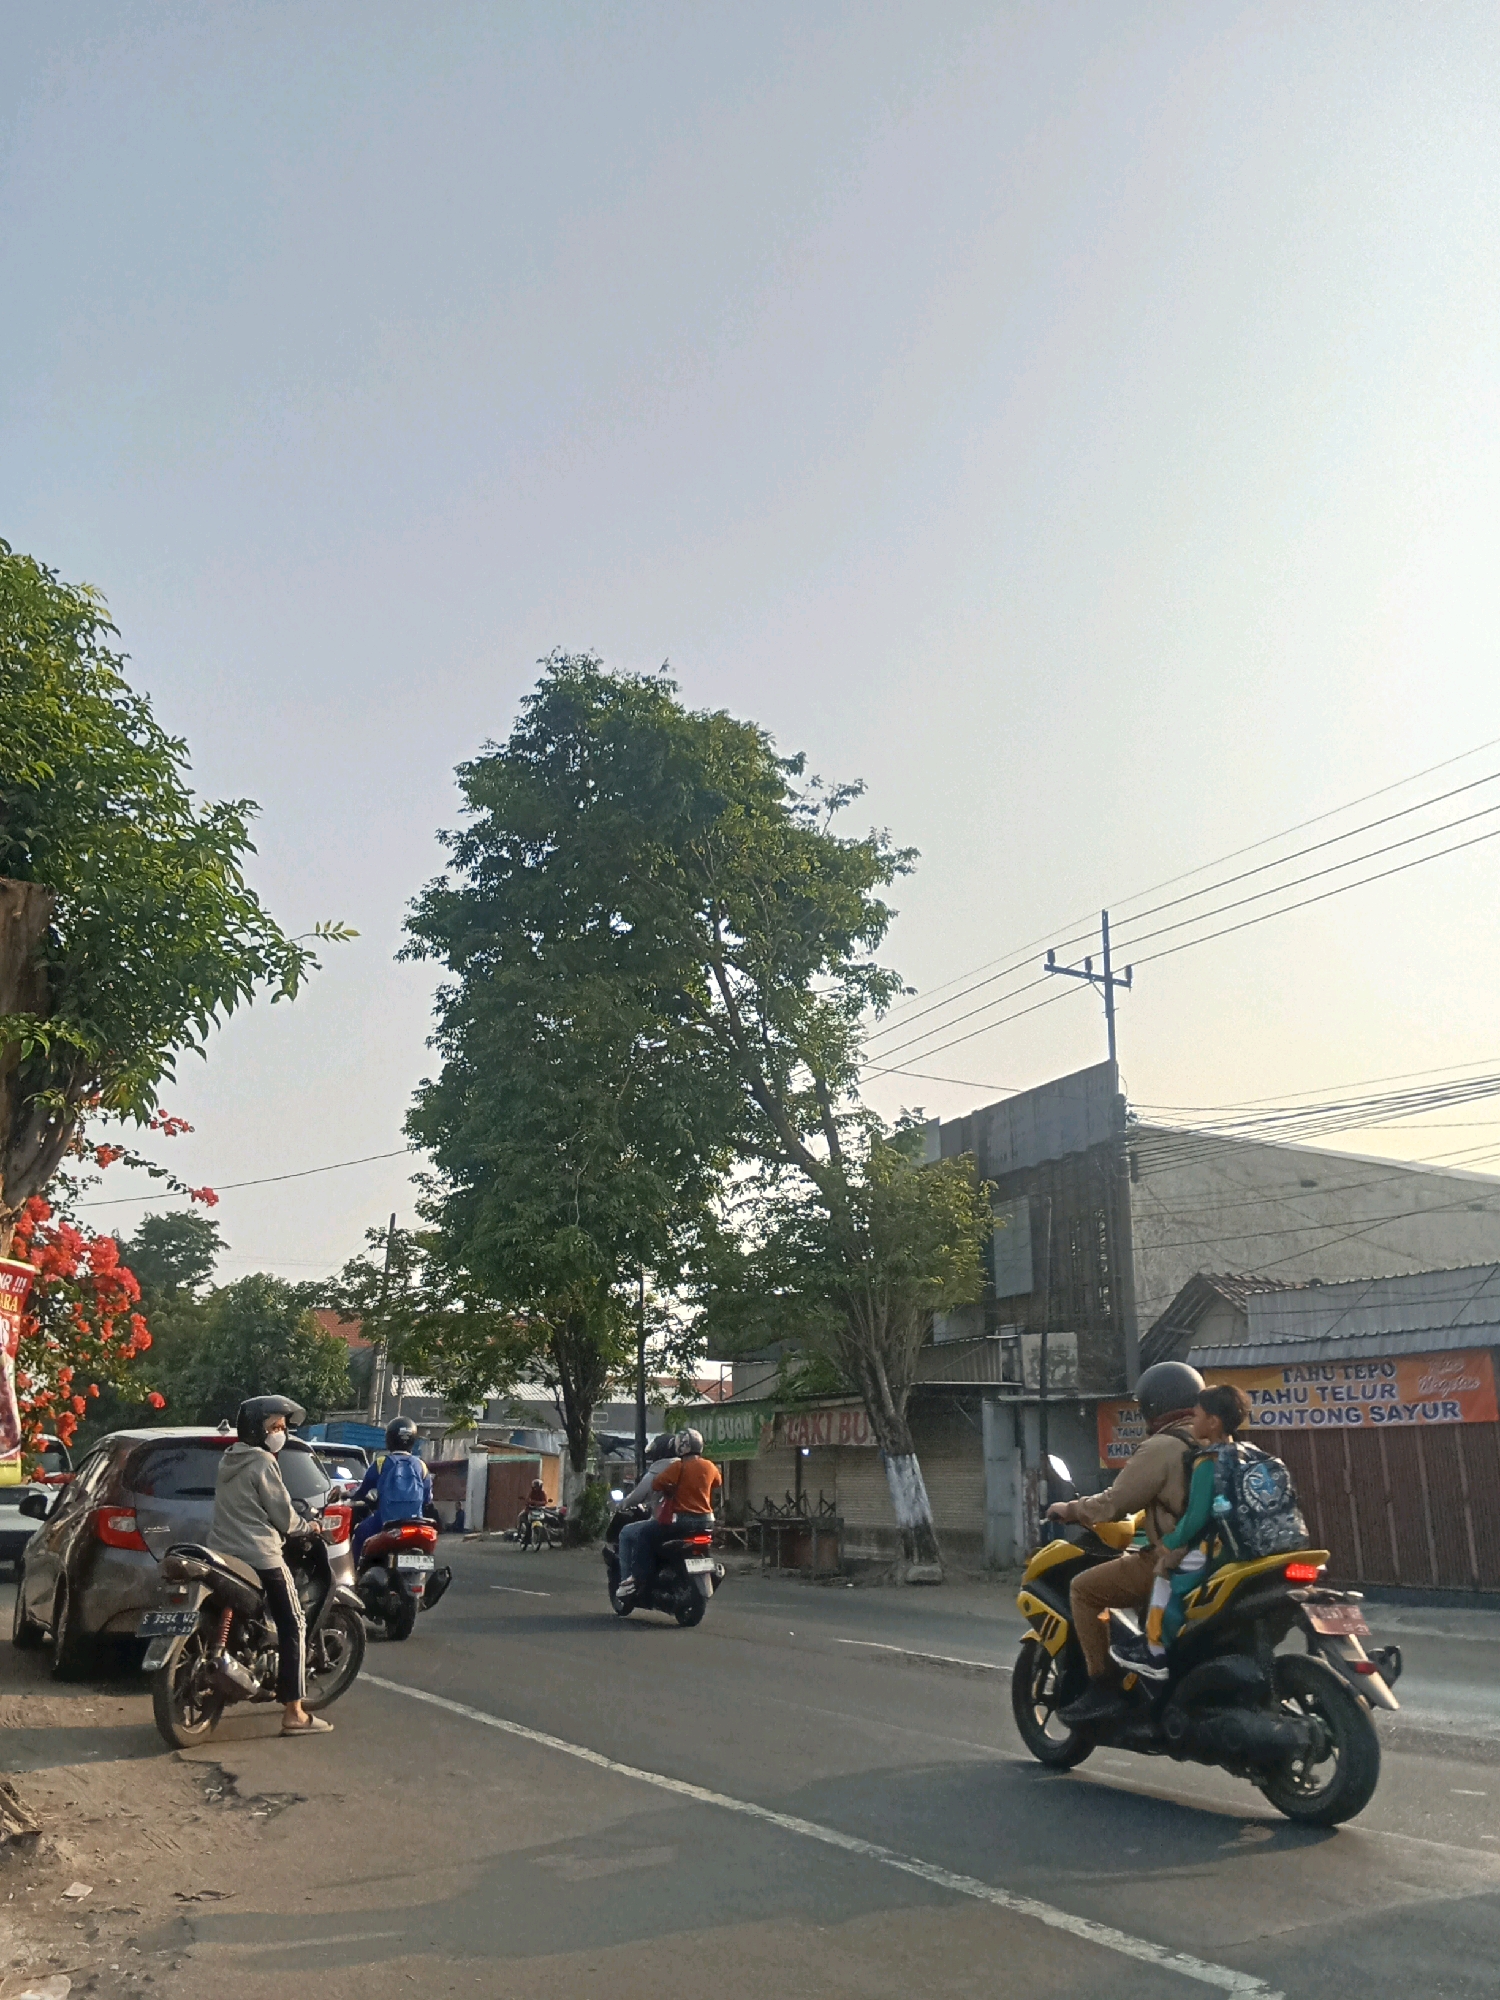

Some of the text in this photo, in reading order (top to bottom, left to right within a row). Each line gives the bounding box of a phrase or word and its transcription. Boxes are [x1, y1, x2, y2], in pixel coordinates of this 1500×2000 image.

[1282, 1360, 1396, 1384] TAHU TEPO
[1247, 1382, 1397, 1405] TAHU TELUR
[1117, 1409, 1145, 1423] TAH
[1248, 1400, 1460, 1426] LONTONG SAYUR
[1115, 1426, 1144, 1438] TAHU
